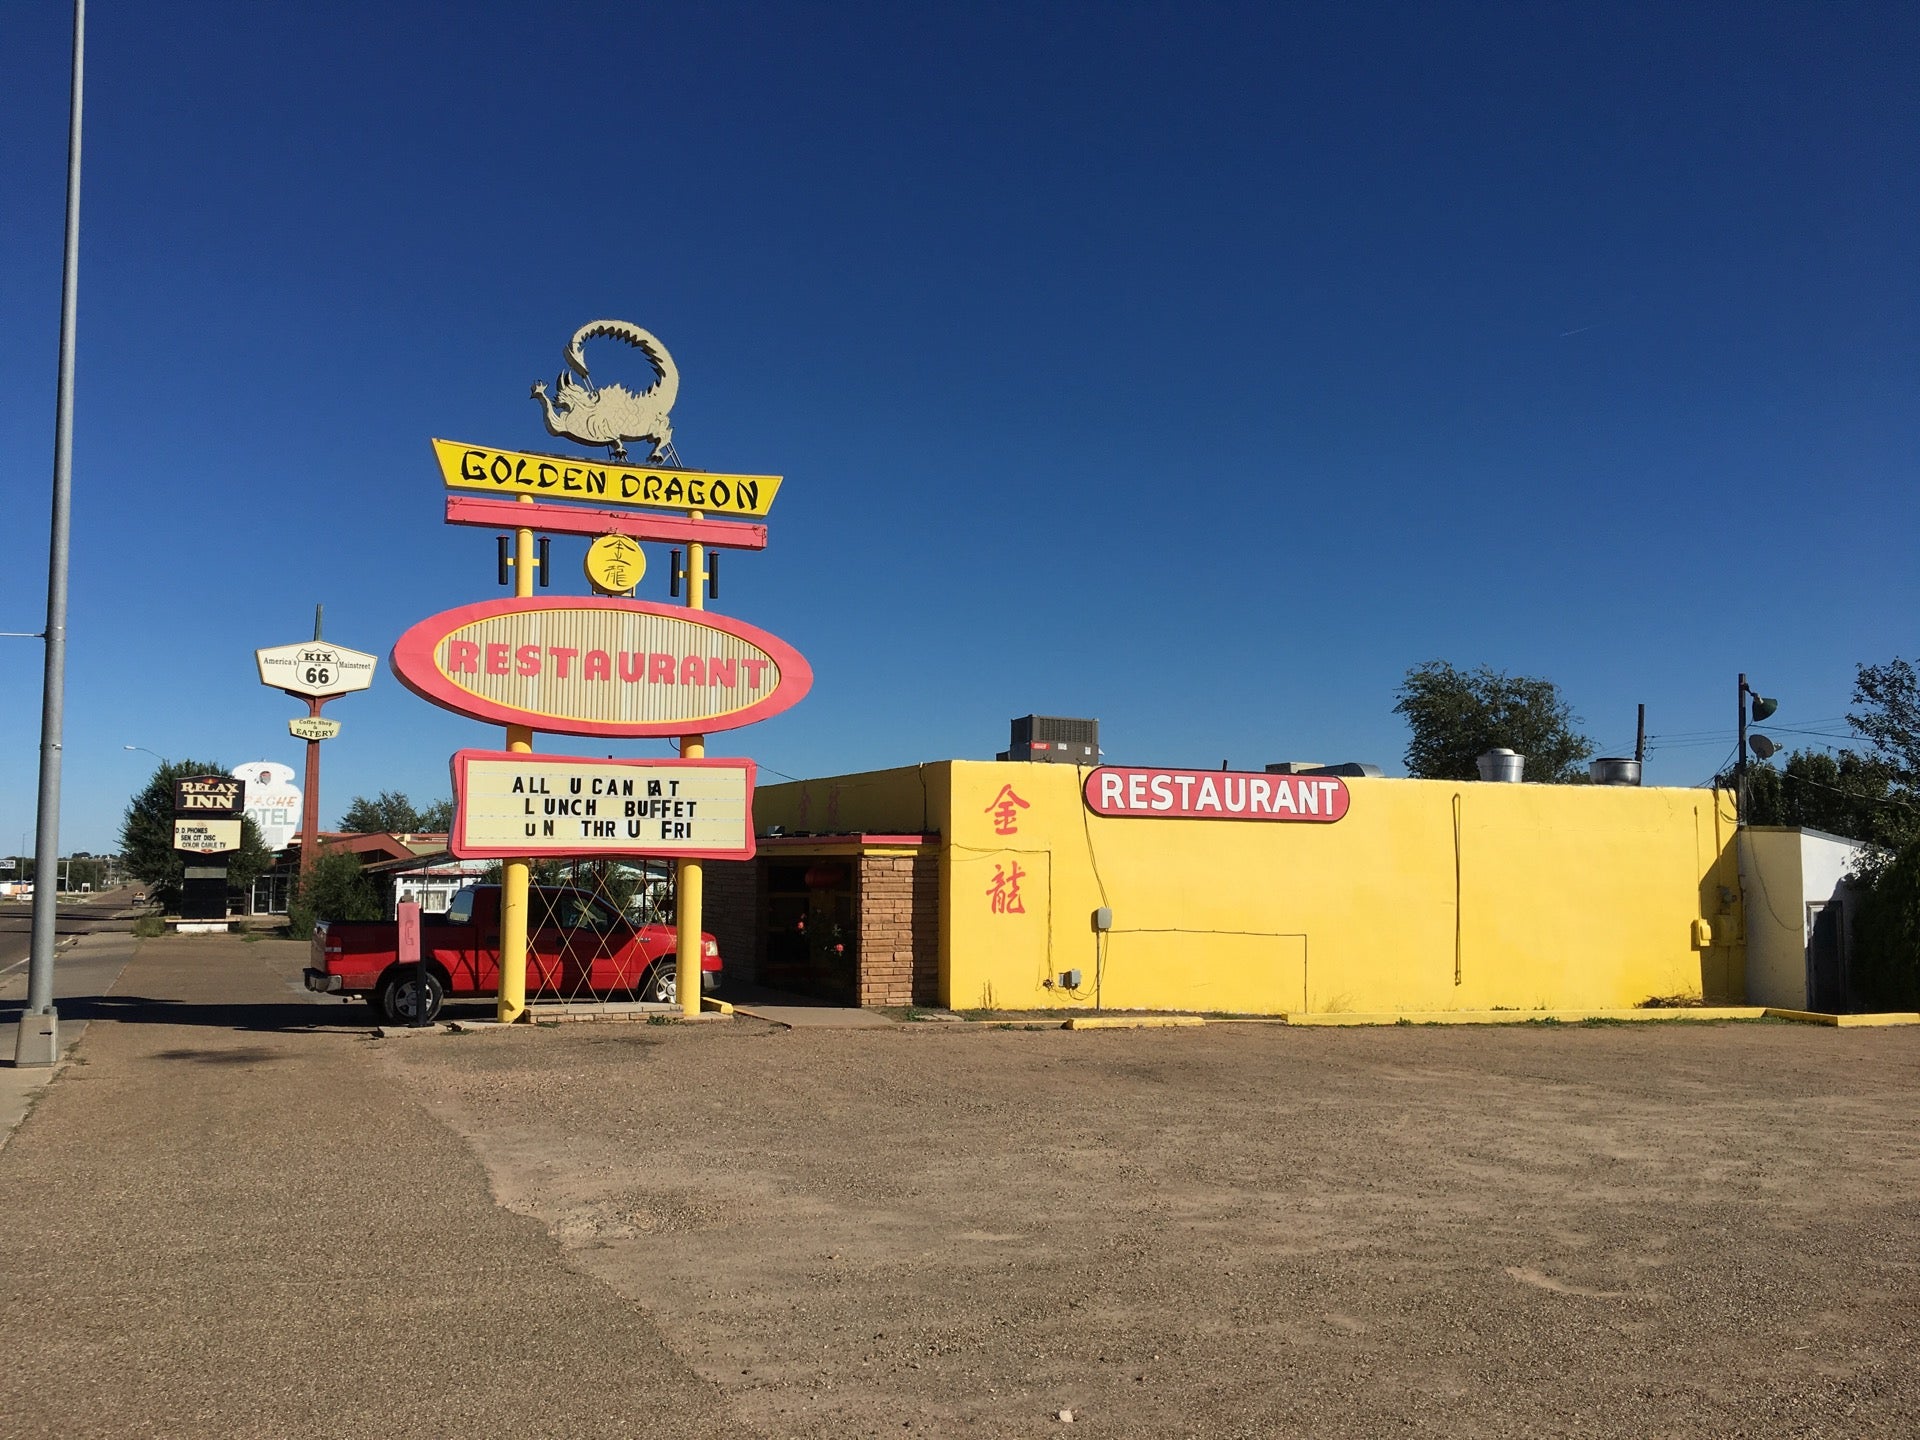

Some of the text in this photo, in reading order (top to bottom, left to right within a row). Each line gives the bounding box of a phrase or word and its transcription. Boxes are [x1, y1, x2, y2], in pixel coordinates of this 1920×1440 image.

[460, 450, 759, 510] GOLDEN DRAGON
[263, 657, 297, 666] America's
[304, 653, 332, 662] KIX
[449, 640, 769, 689] RESTAURANT
[339, 662, 371, 670] Mainstreet
[306, 668, 329, 684] 66
[296, 728, 335, 738] EATERY
[181, 782, 239, 796] RELAX
[512, 776, 550, 794] ALL
[183, 794, 236, 809] INN
[1101, 772, 1339, 816] RESTAURANT
[625, 799, 697, 818] BUFFET
[661, 820, 692, 840] FRI
